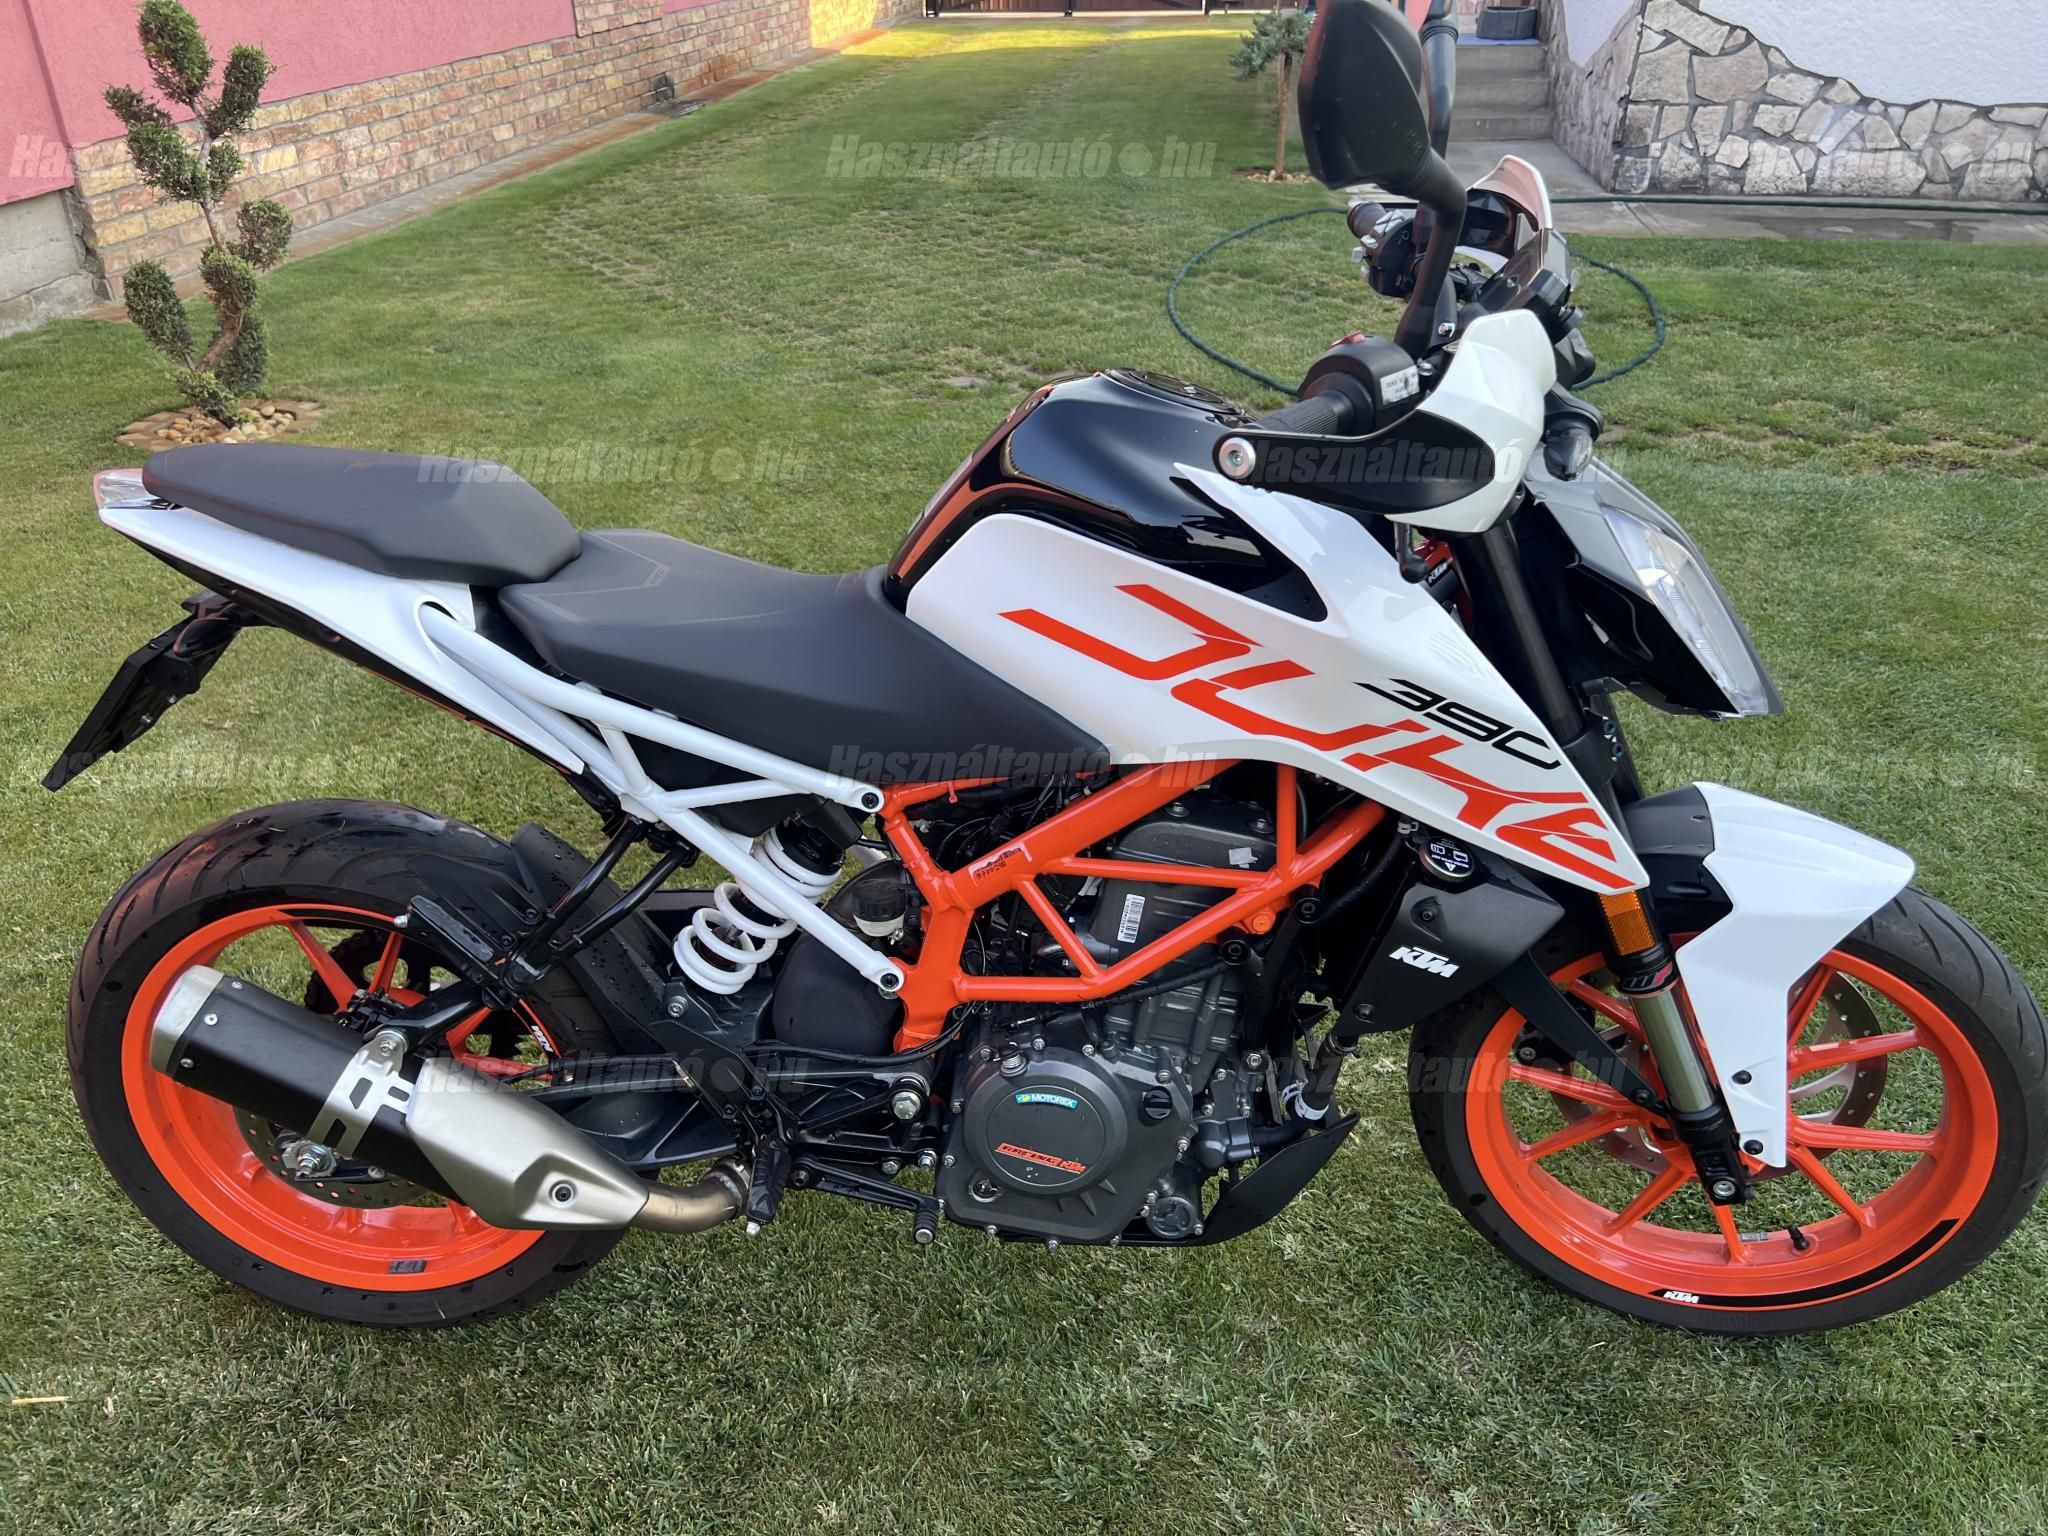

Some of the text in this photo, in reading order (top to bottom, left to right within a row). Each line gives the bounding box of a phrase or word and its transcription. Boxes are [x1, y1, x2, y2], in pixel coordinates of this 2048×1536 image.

[1352, 678, 1562, 770] 390
[1389, 946, 1459, 978] KTM
[531, 1025, 554, 1053] KTM
[1031, 1093, 1074, 1108] MOTOREX
[1001, 1145, 1057, 1164] RACING
[1663, 1290, 1700, 1304] KTM
